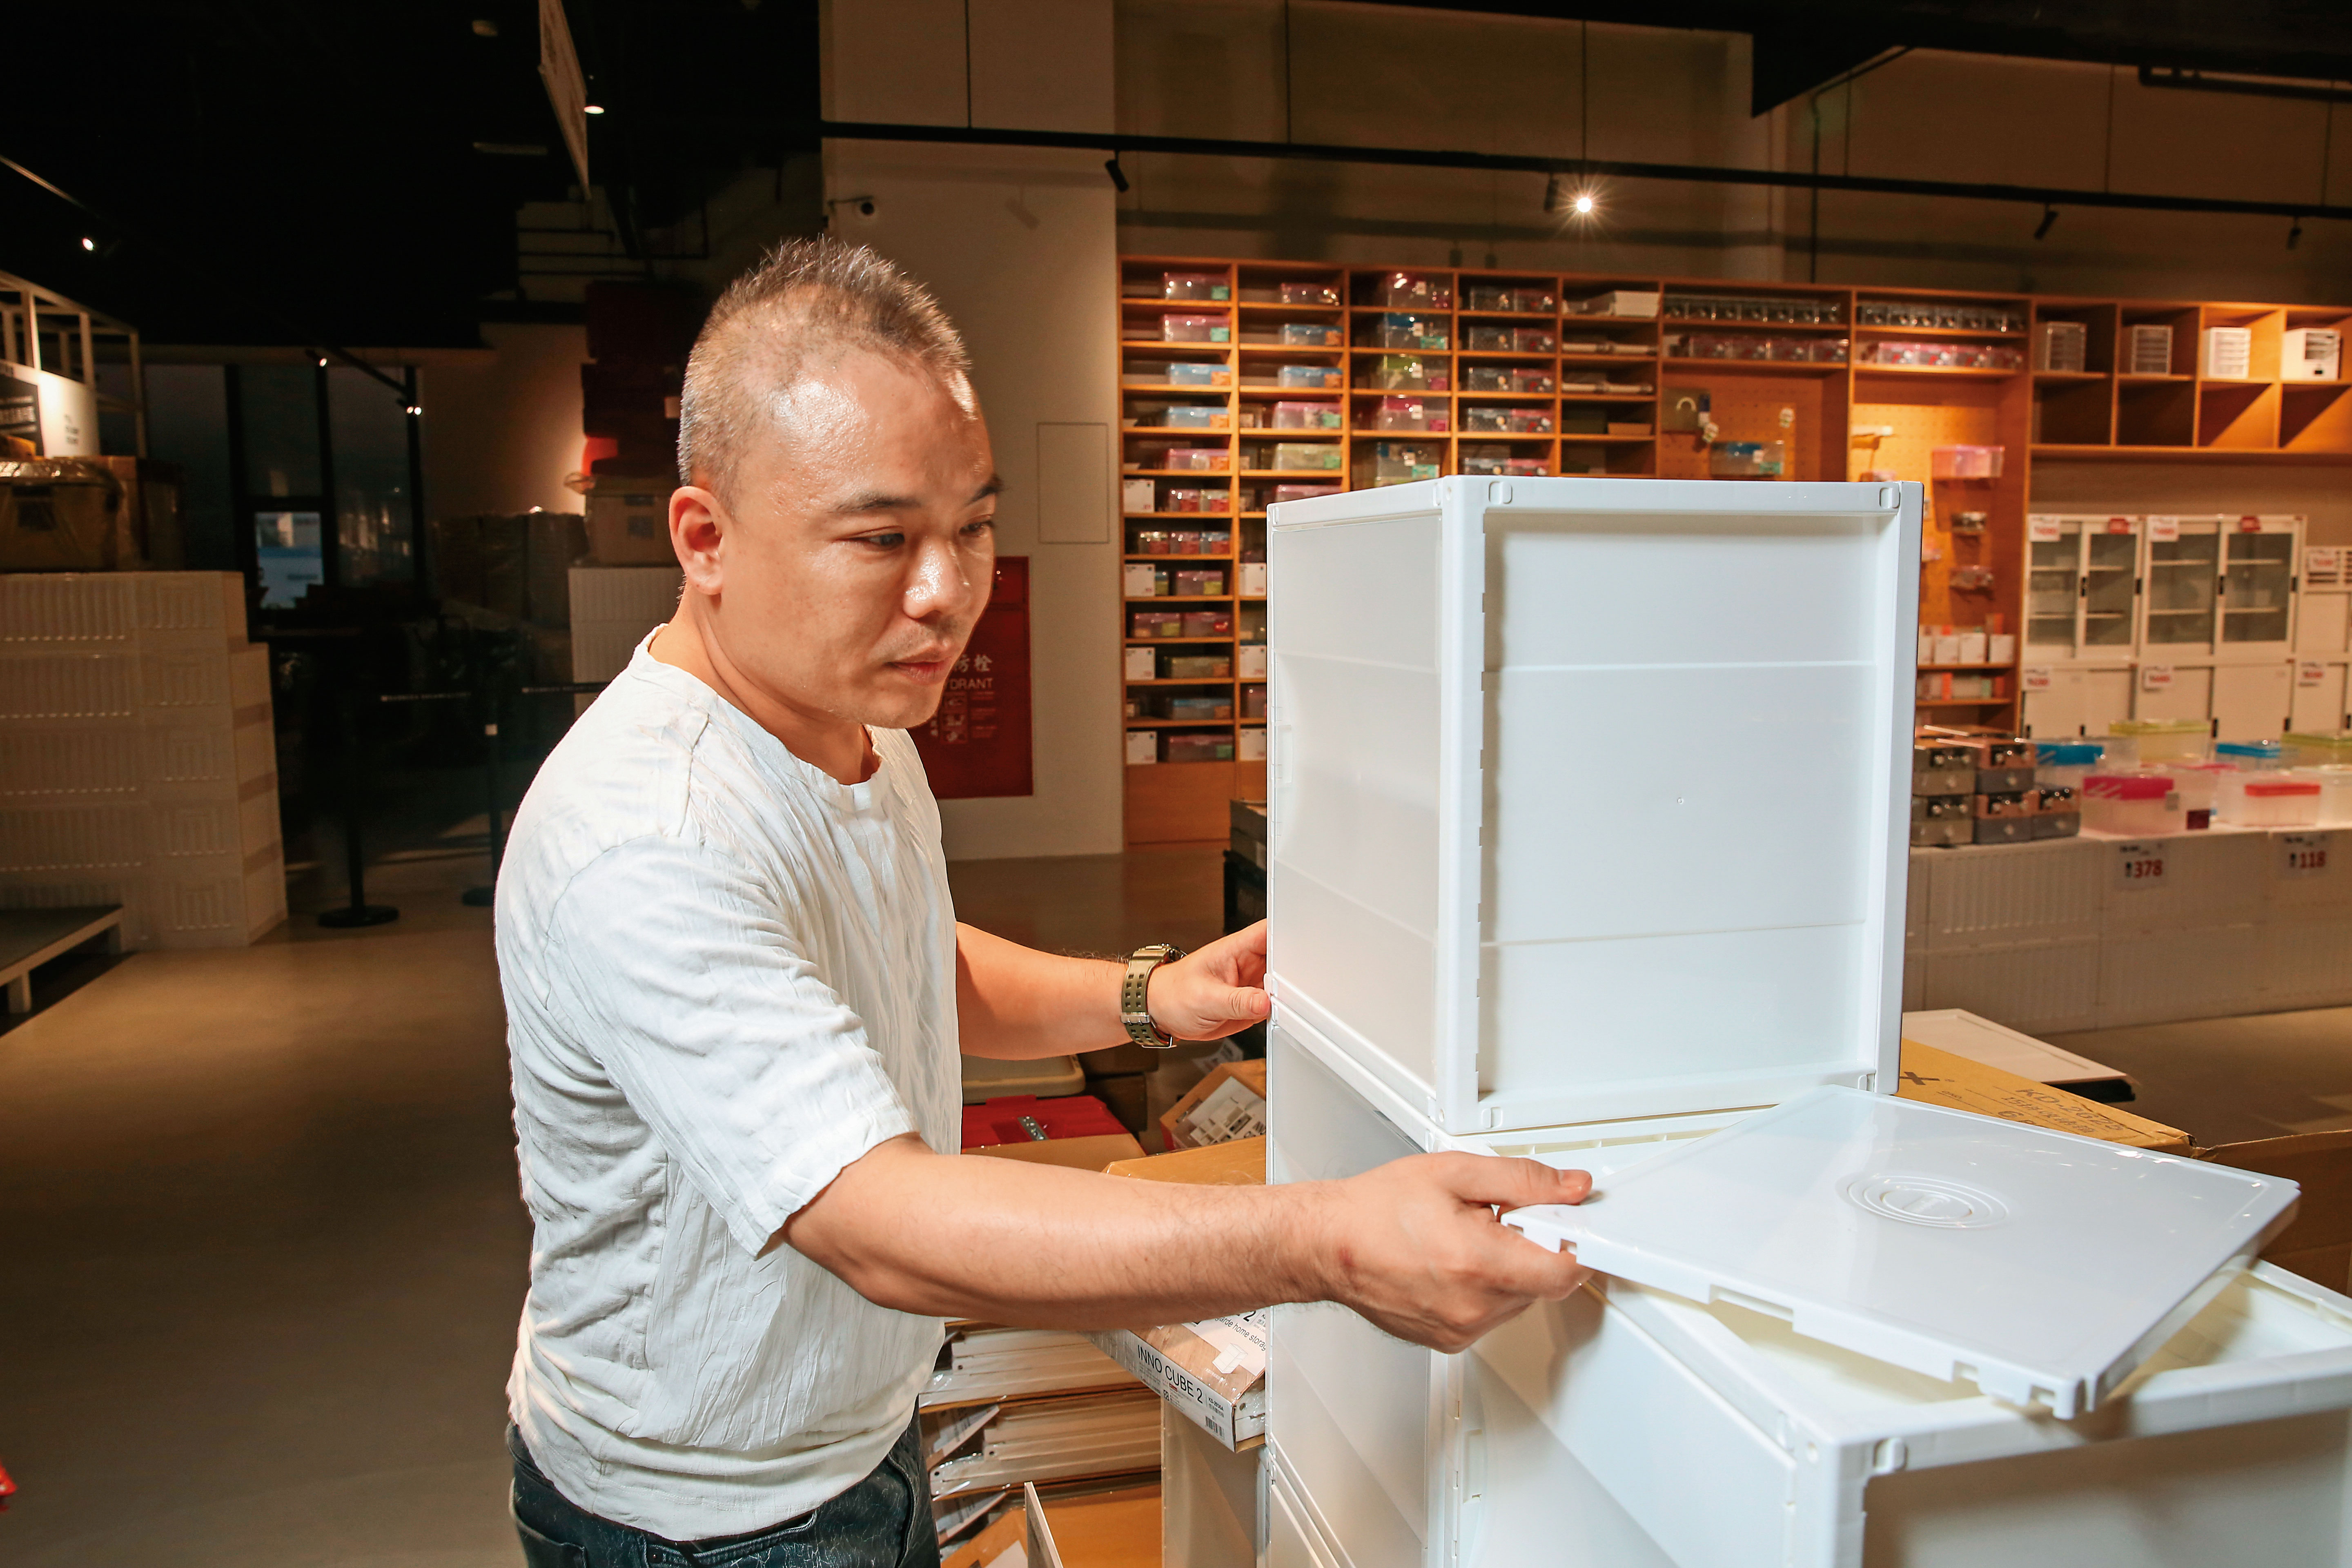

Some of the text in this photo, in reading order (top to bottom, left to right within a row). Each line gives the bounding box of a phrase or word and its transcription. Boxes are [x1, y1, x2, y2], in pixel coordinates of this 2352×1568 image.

[2134, 859, 2163, 879] 378
[1232, 1323, 1250, 1337] home
[1138, 1345, 1162, 1373] INNO
[1165, 1365, 1194, 1397] CUBE
[1197, 1388, 1203, 1404] 2
